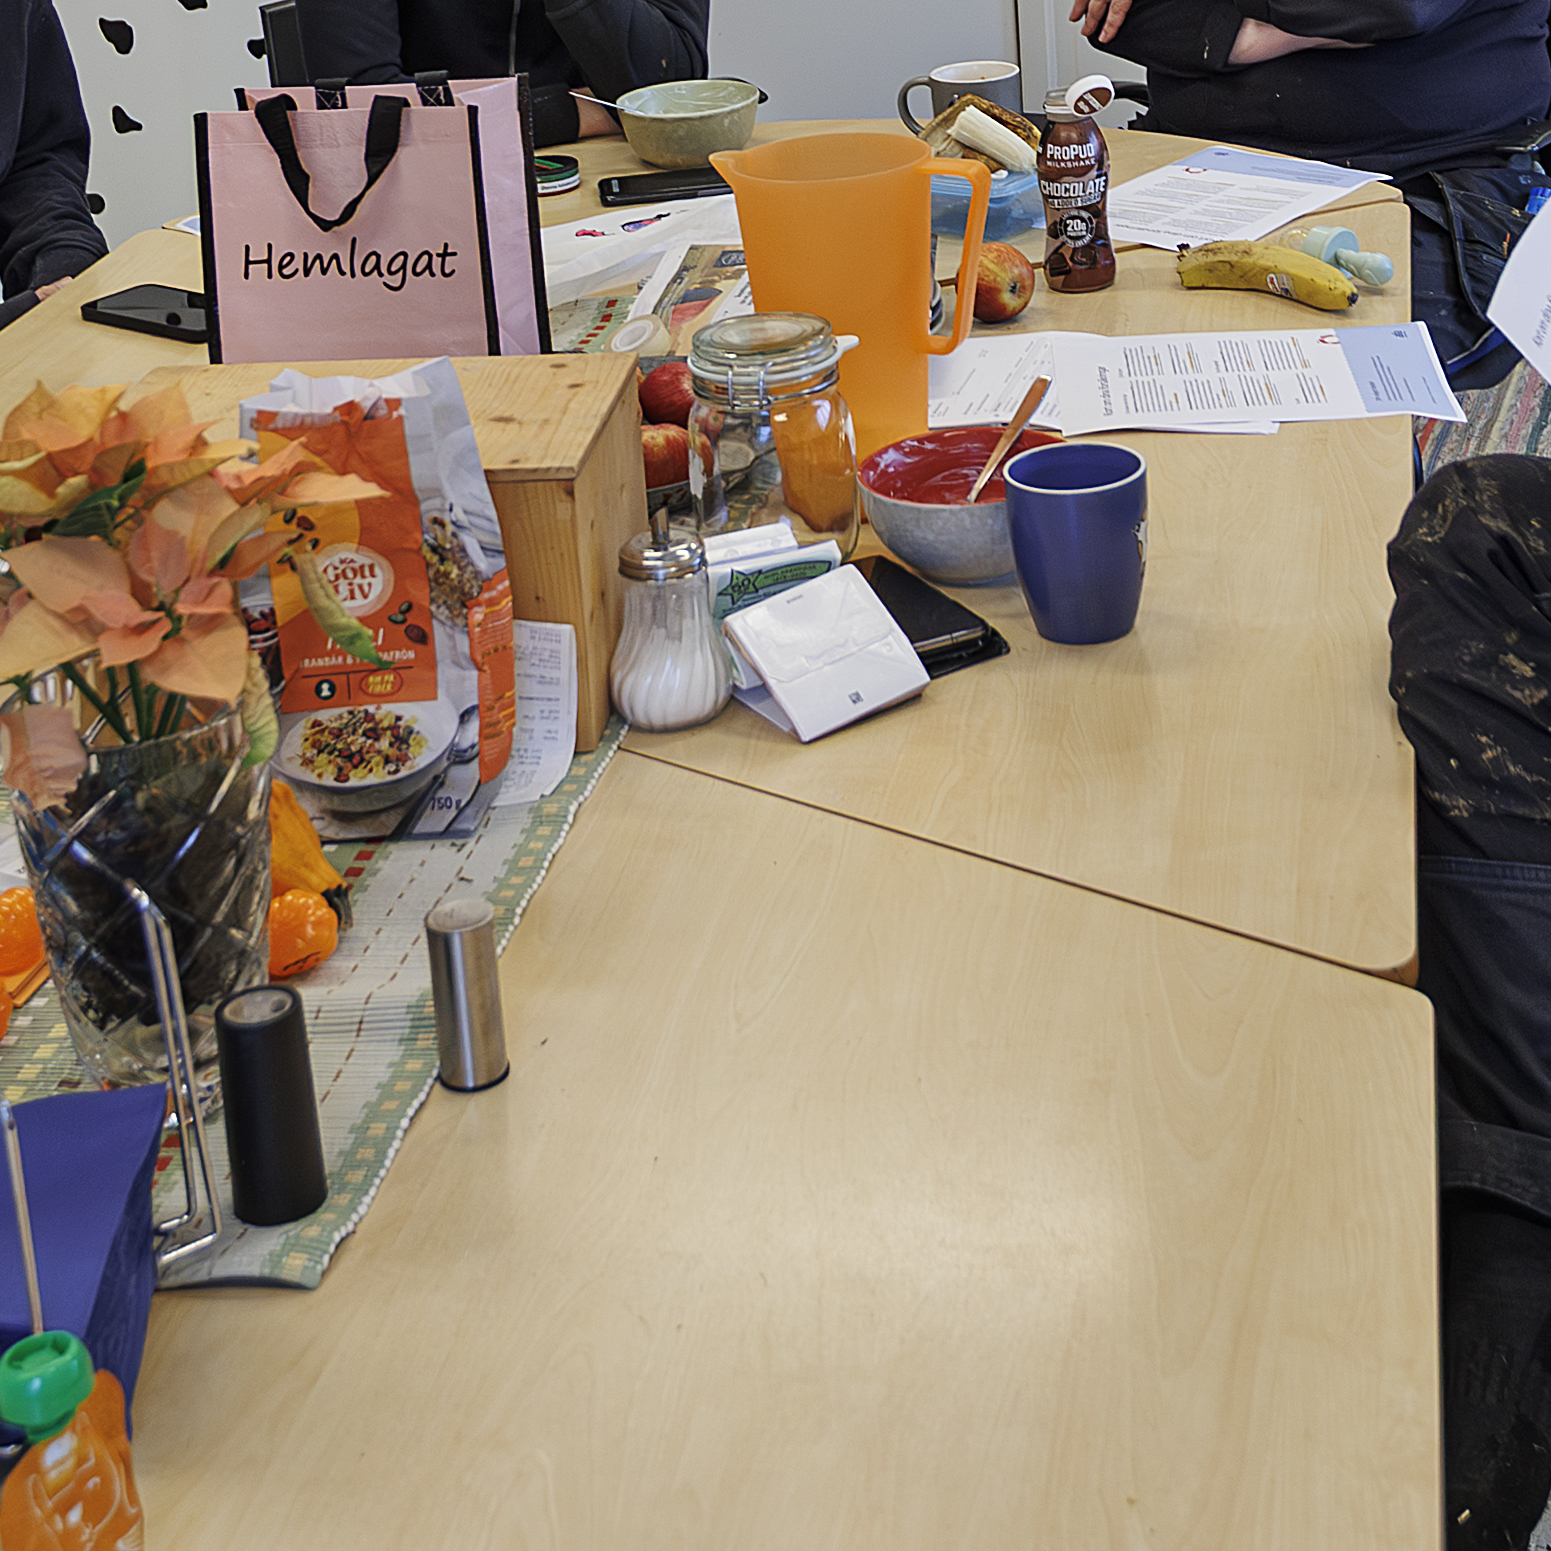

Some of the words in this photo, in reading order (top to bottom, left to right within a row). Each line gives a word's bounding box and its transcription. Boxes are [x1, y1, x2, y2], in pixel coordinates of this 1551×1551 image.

[1046, 158, 1096, 168] MILKSHAKE
[1040, 175, 1107, 198] CHOCOLATE
[243, 236, 458, 292] Hemlagat
[322, 562, 377, 584] Gott
